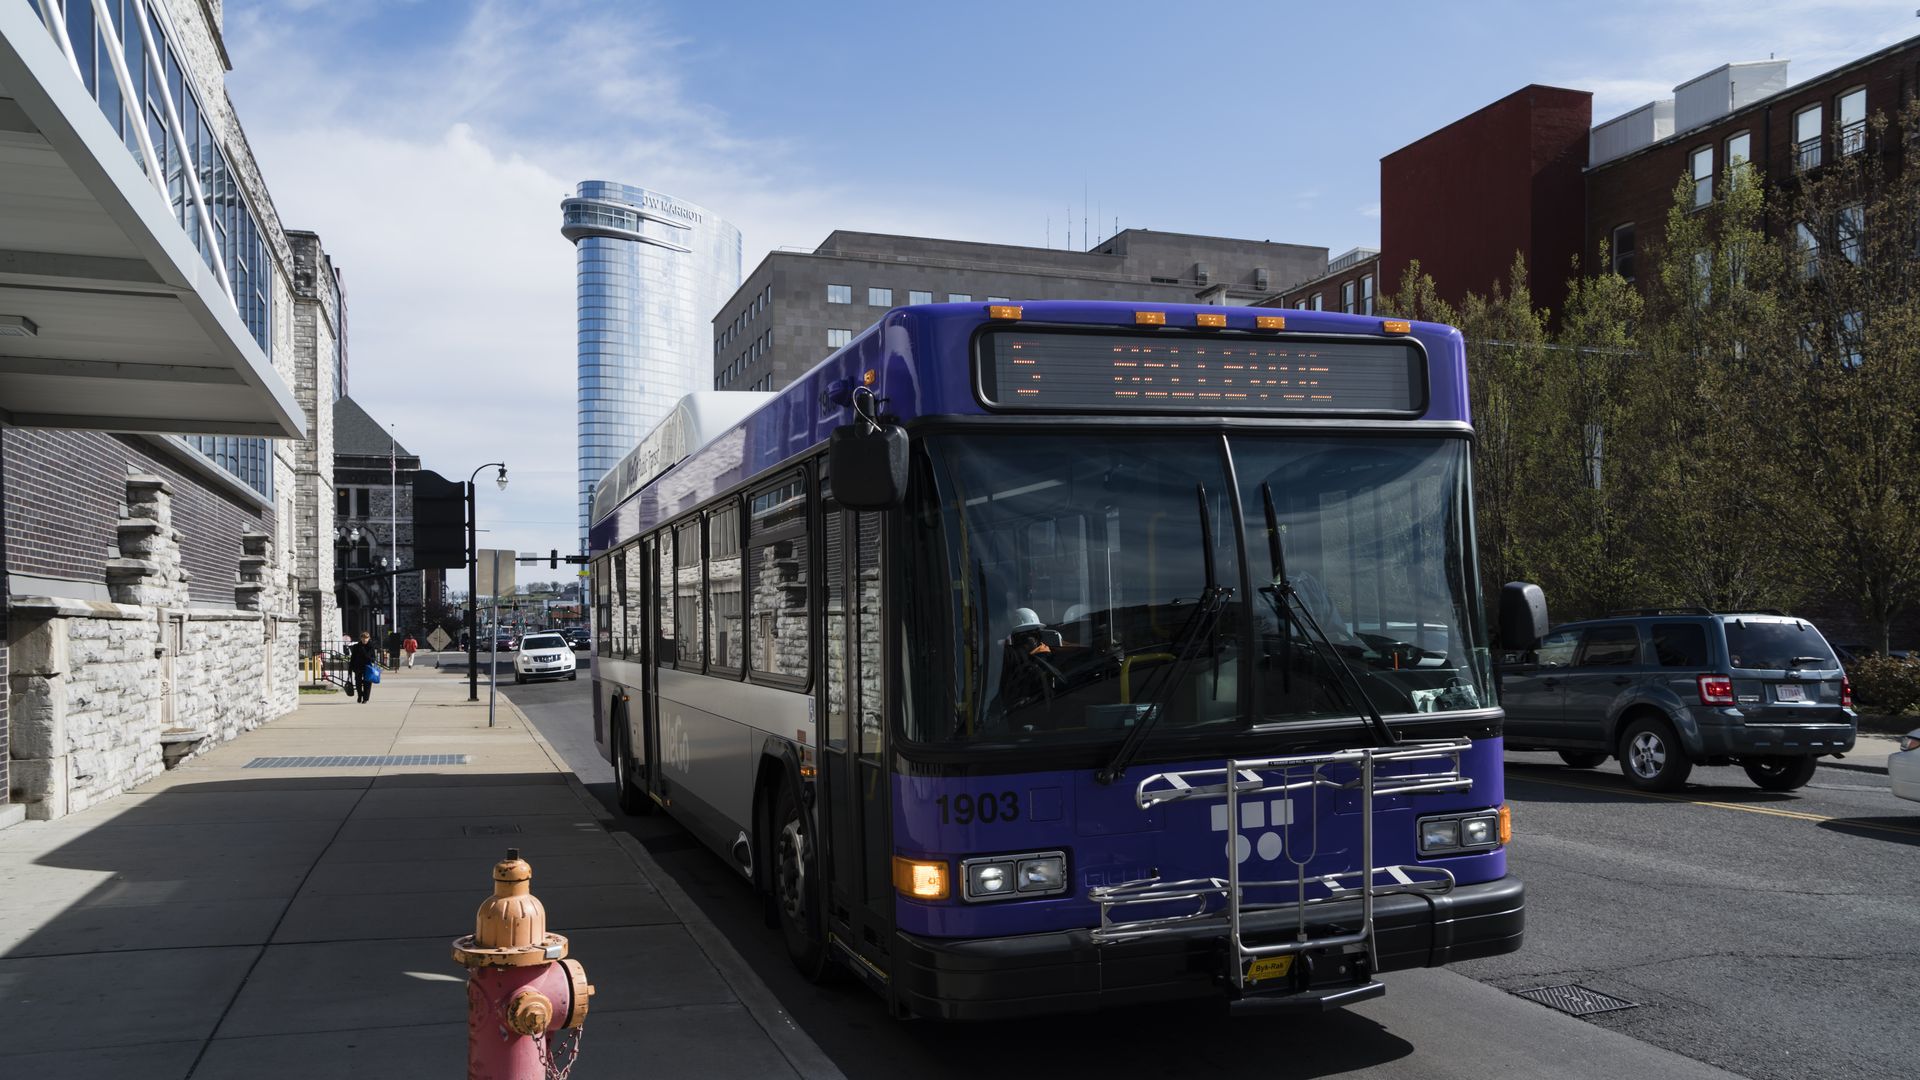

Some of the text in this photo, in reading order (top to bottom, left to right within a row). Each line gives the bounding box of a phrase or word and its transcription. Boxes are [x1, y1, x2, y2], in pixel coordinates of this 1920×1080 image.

[642, 195, 702, 224] JW MARRIOTT
[936, 791, 1020, 825] 1903
